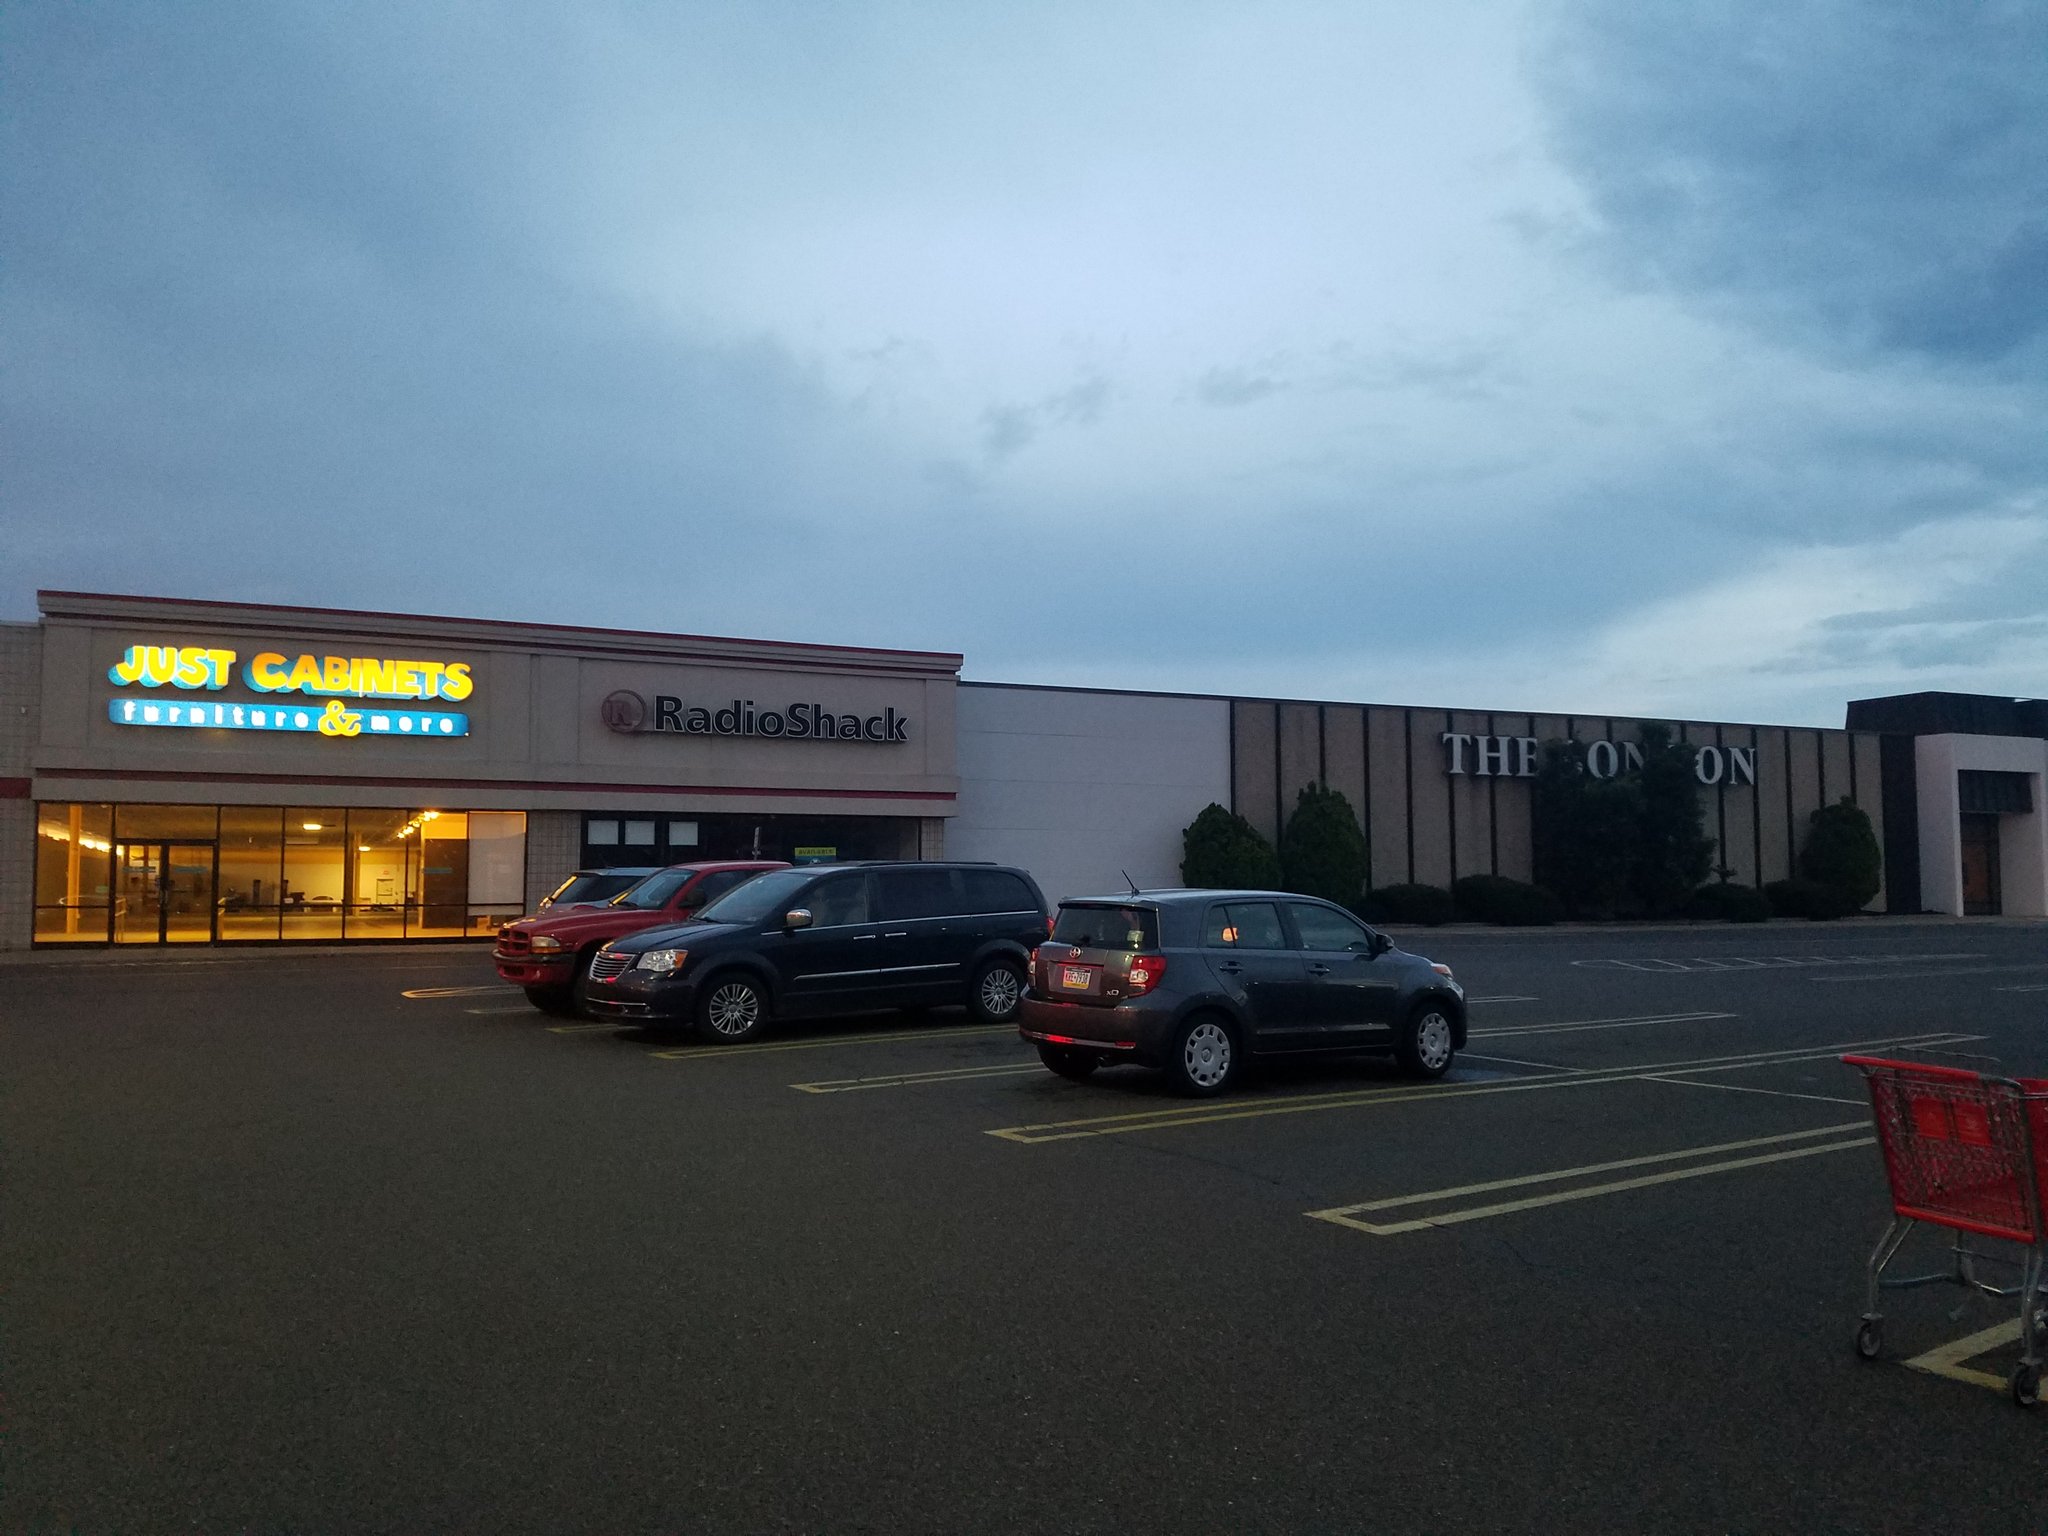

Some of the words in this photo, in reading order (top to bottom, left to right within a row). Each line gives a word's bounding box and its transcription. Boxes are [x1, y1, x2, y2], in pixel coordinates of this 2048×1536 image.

[110, 645, 237, 689] JUST
[244, 652, 474, 701] CABINETS
[124, 700, 310, 729] furniture
[317, 700, 362, 737] &
[370, 714, 454, 733] more
[653, 695, 909, 741] RadioShack
[1442, 733, 1538, 777] THE
